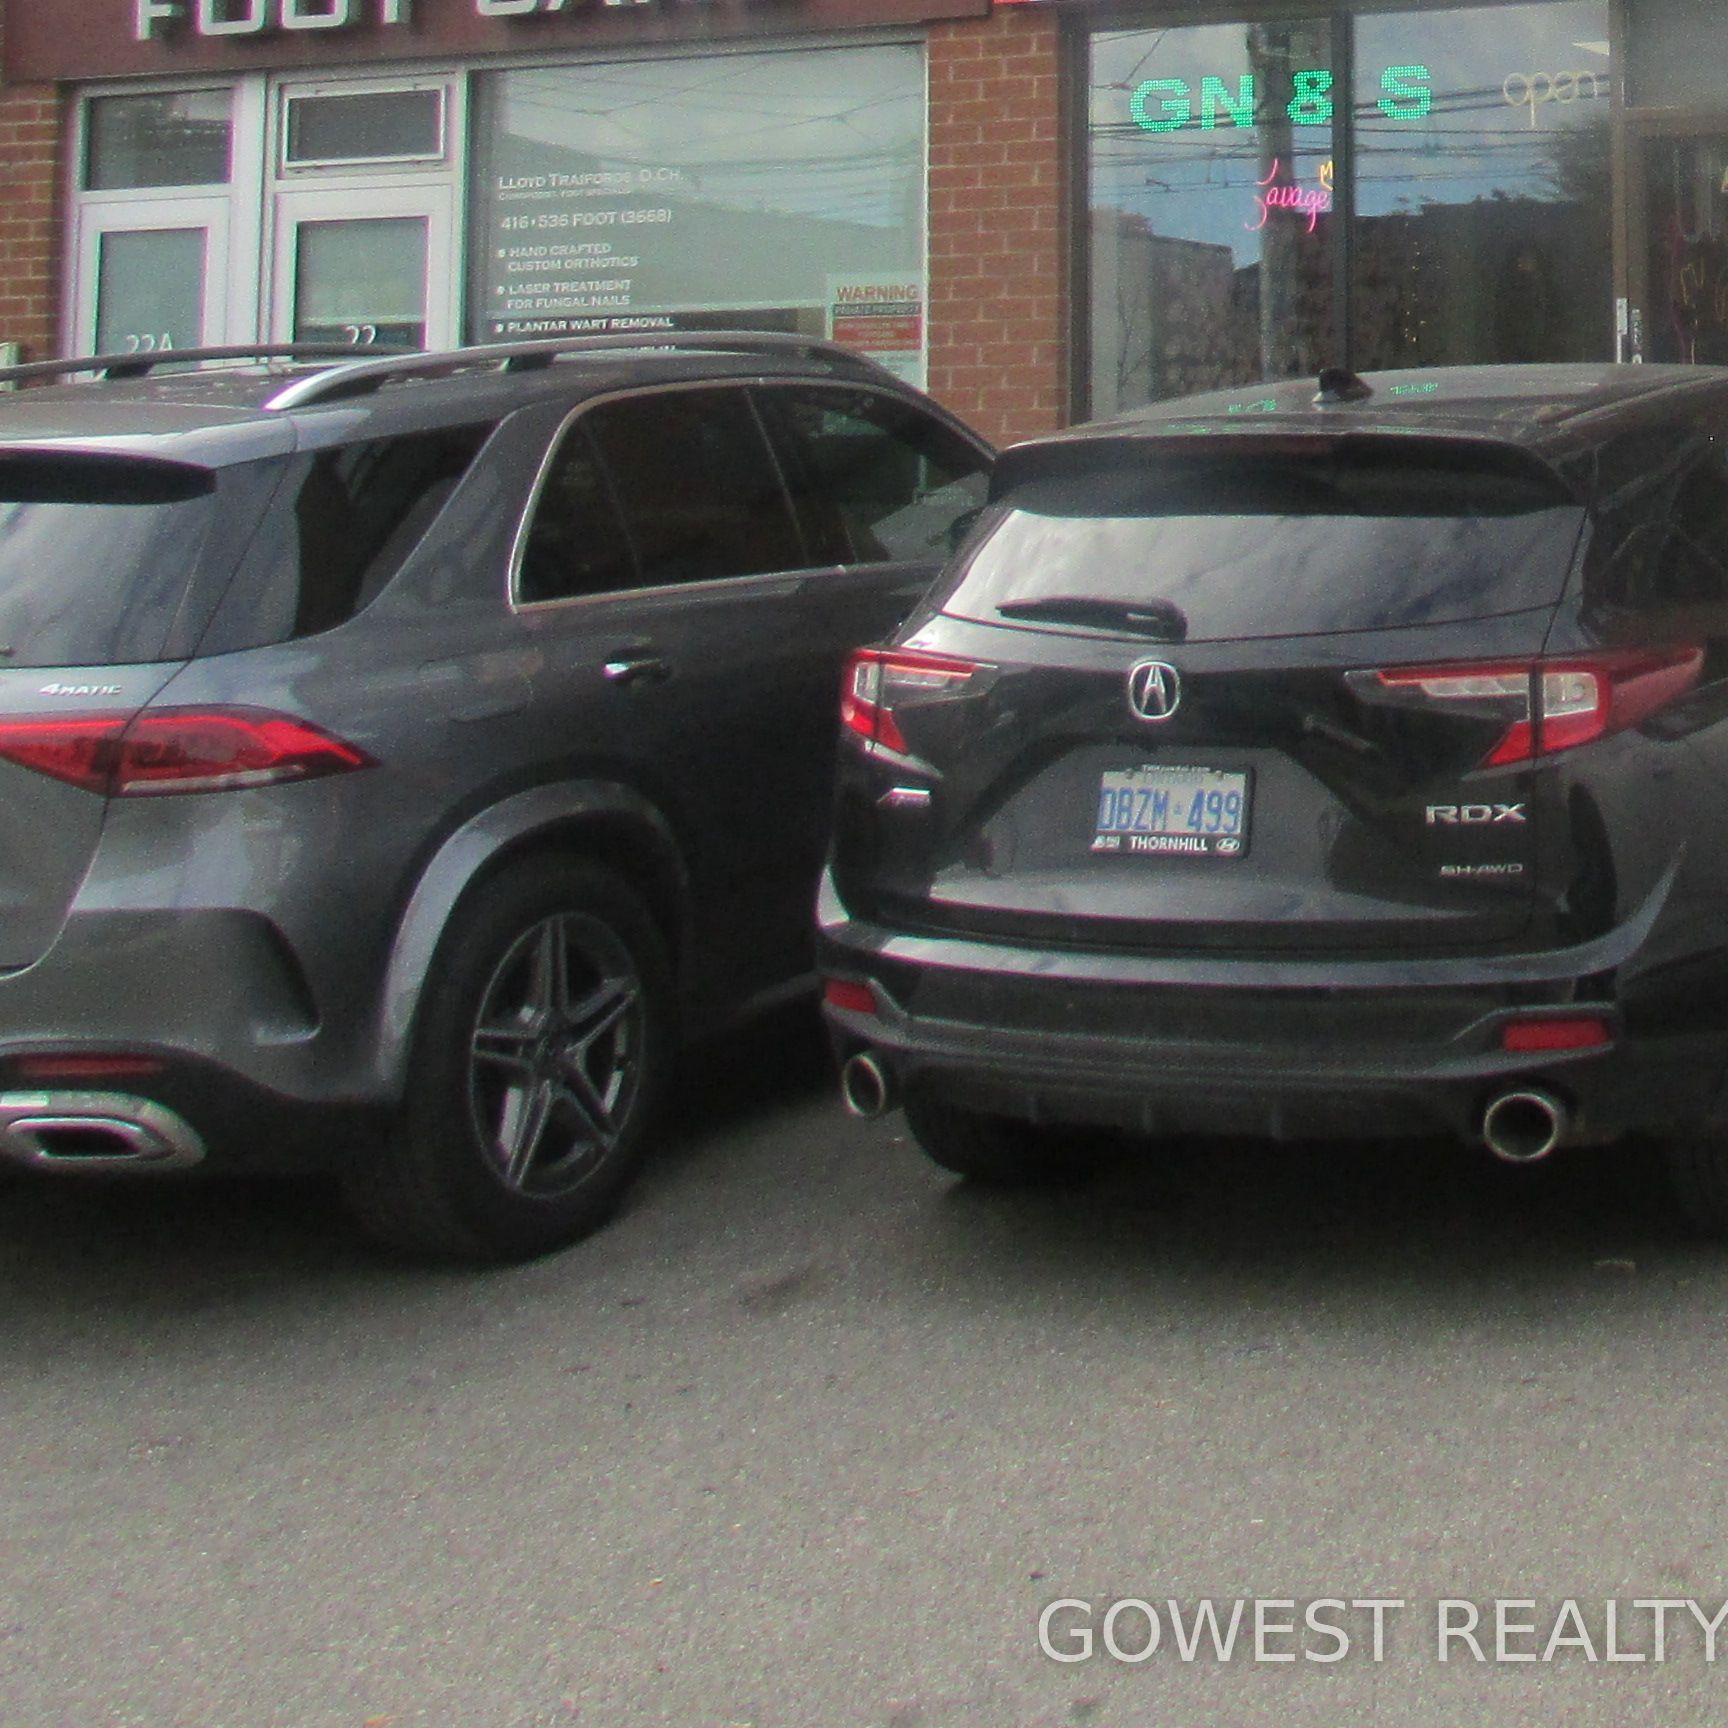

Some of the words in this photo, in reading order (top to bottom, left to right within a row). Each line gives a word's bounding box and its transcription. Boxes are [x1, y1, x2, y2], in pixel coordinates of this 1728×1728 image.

[1130, 74, 1255, 132] GN
[1377, 65, 1432, 120] S
[1502, 70, 1599, 129] open
[573, 211, 618, 227] FOOT
[509, 246, 547, 258] HAND
[507, 259, 562, 272] CUSTOM
[509, 282, 550, 295] LASER
[553, 279, 632, 293] TREATMENT
[836, 283, 919, 302] WARNING
[507, 298, 532, 309] FOR
[536, 296, 590, 308] FUNGAL
[591, 295, 631, 306] NAILS
[507, 320, 567, 333] PLANTAR
[570, 318, 608, 330] WART
[611, 316, 674, 328] REMOVAL
[1096, 787, 1169, 831] DBZM
[1187, 788, 1242, 833] 499
[1426, 803, 1527, 824] RDX
[1129, 835, 1209, 852] THORNHILL
